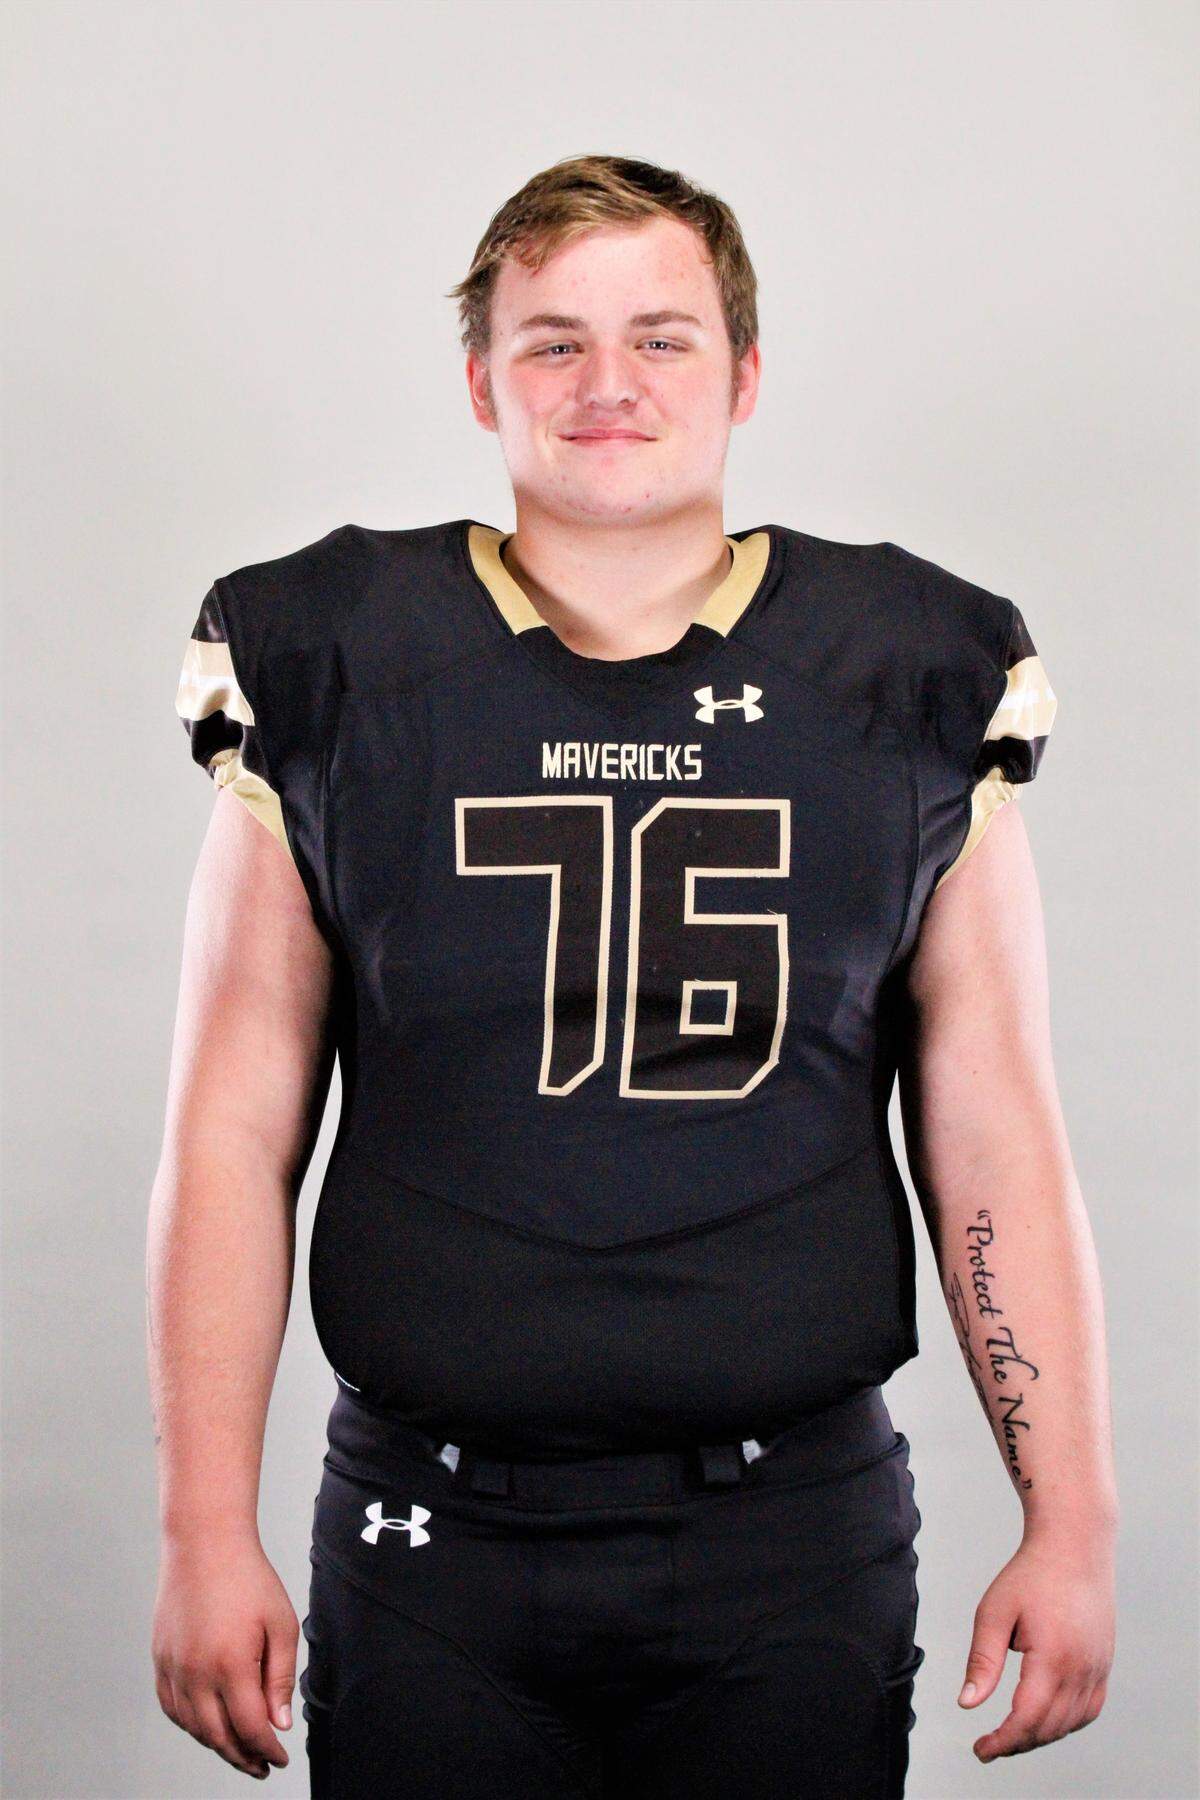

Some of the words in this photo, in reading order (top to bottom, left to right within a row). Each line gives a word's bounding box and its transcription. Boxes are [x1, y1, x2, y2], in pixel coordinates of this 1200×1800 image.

[542, 742, 702, 780] MAVERICKS
[455, 795, 790, 1099] 76
[986, 1326, 1040, 1385] The
